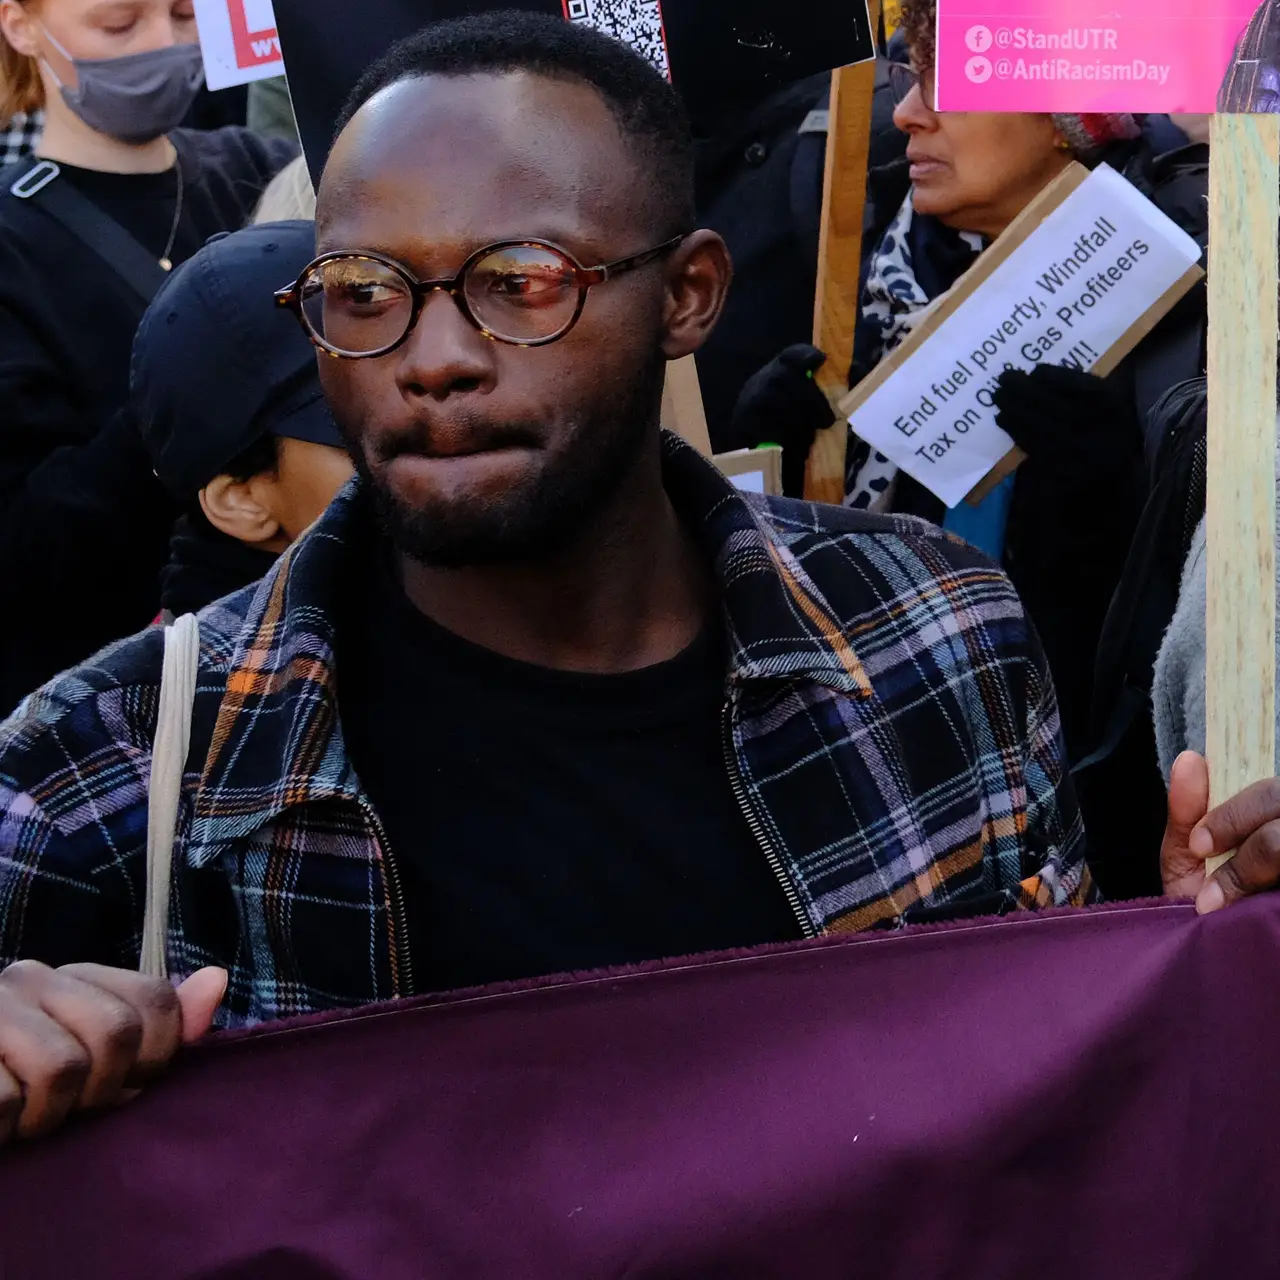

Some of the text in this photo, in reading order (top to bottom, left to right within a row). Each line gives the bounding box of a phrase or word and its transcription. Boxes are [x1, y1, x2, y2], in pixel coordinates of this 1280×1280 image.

[995, 27, 1118, 50] @StandUTR
[995, 58, 1170, 85] @AntiRacismDay
[893, 216, 1118, 438] End fuel poverty, Windfall
[915, 434, 956, 466] Tax
[954, 407, 981, 434] on
[1020, 326, 1063, 363] Gas
[1056, 238, 1150, 326] Profiteers
